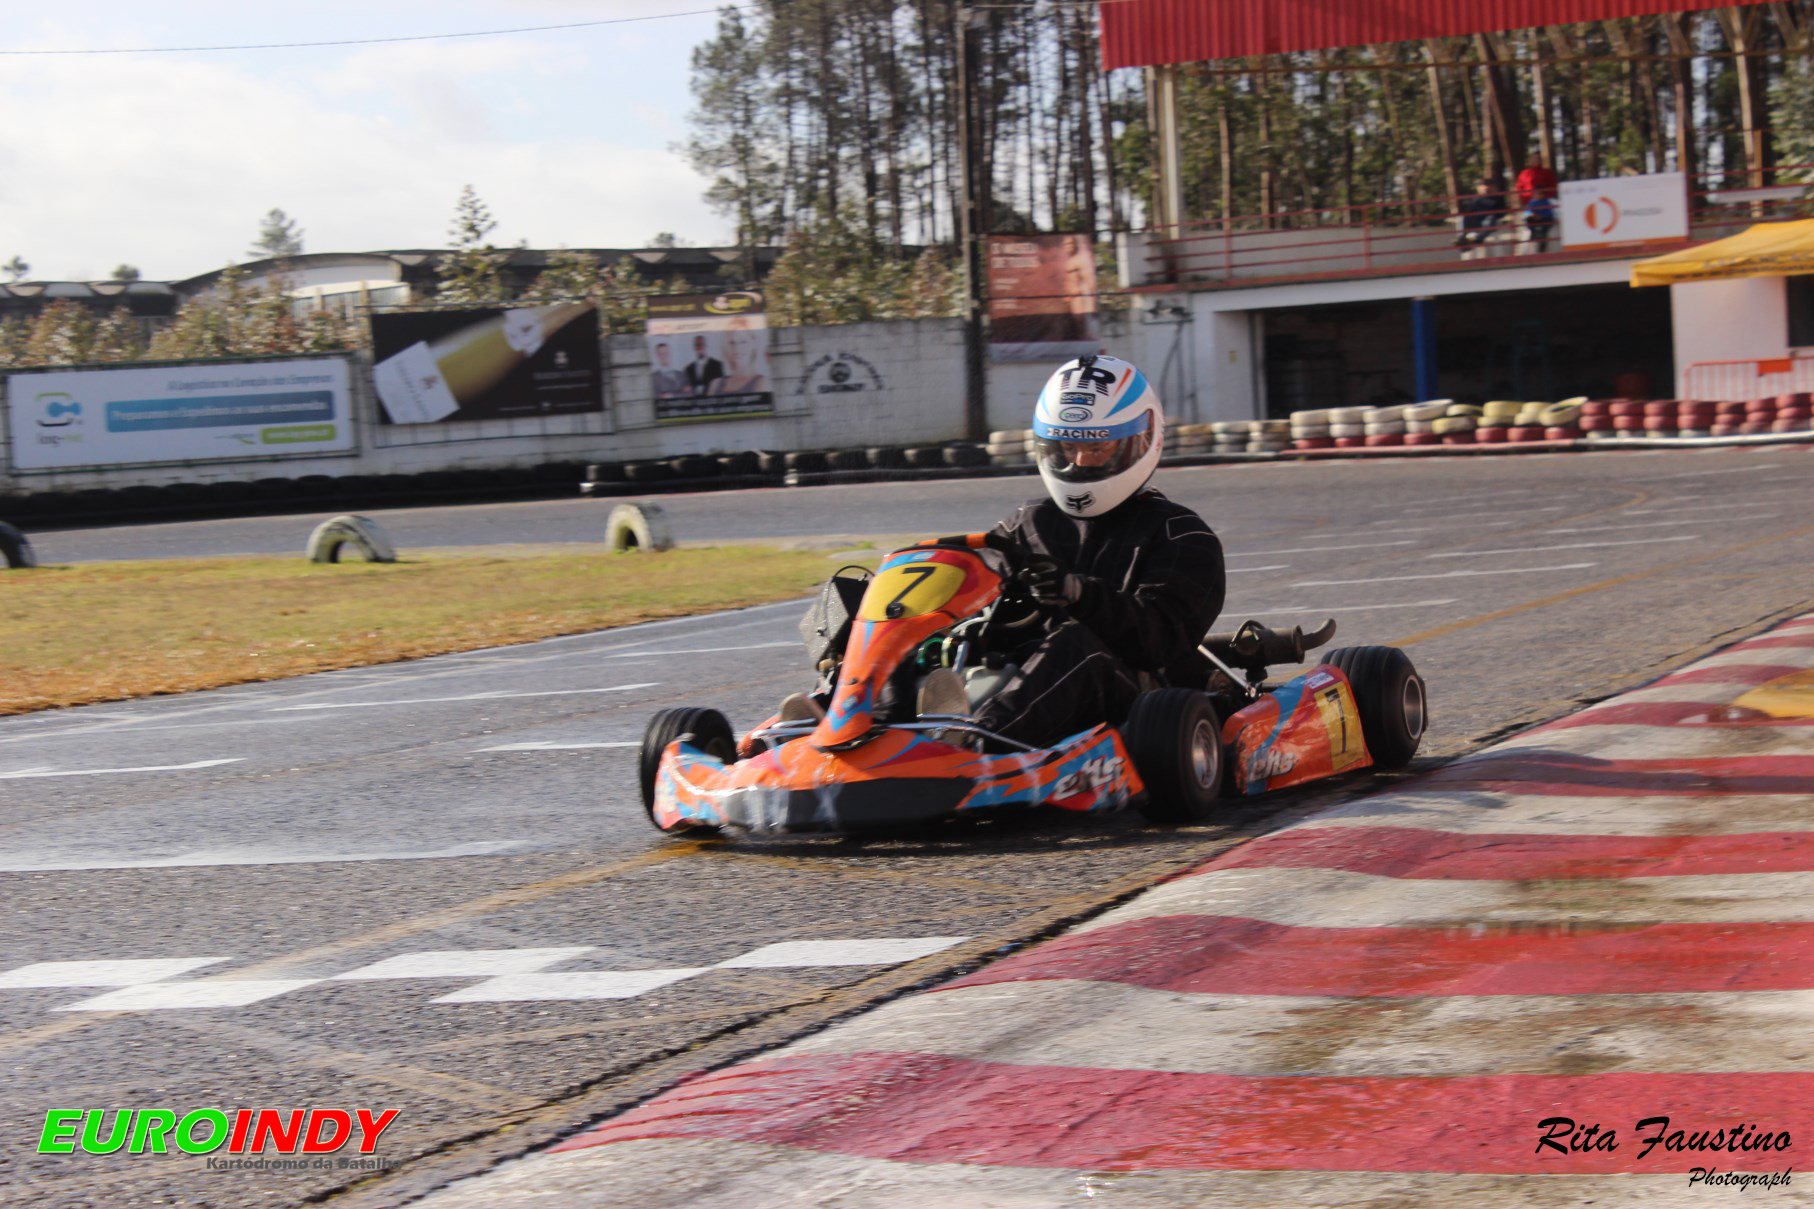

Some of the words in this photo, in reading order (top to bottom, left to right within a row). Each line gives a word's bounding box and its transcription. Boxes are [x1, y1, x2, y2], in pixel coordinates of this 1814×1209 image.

[1053, 428, 1110, 438] RACING
[887, 566, 937, 614] 7
[1324, 687, 1348, 753] 7
